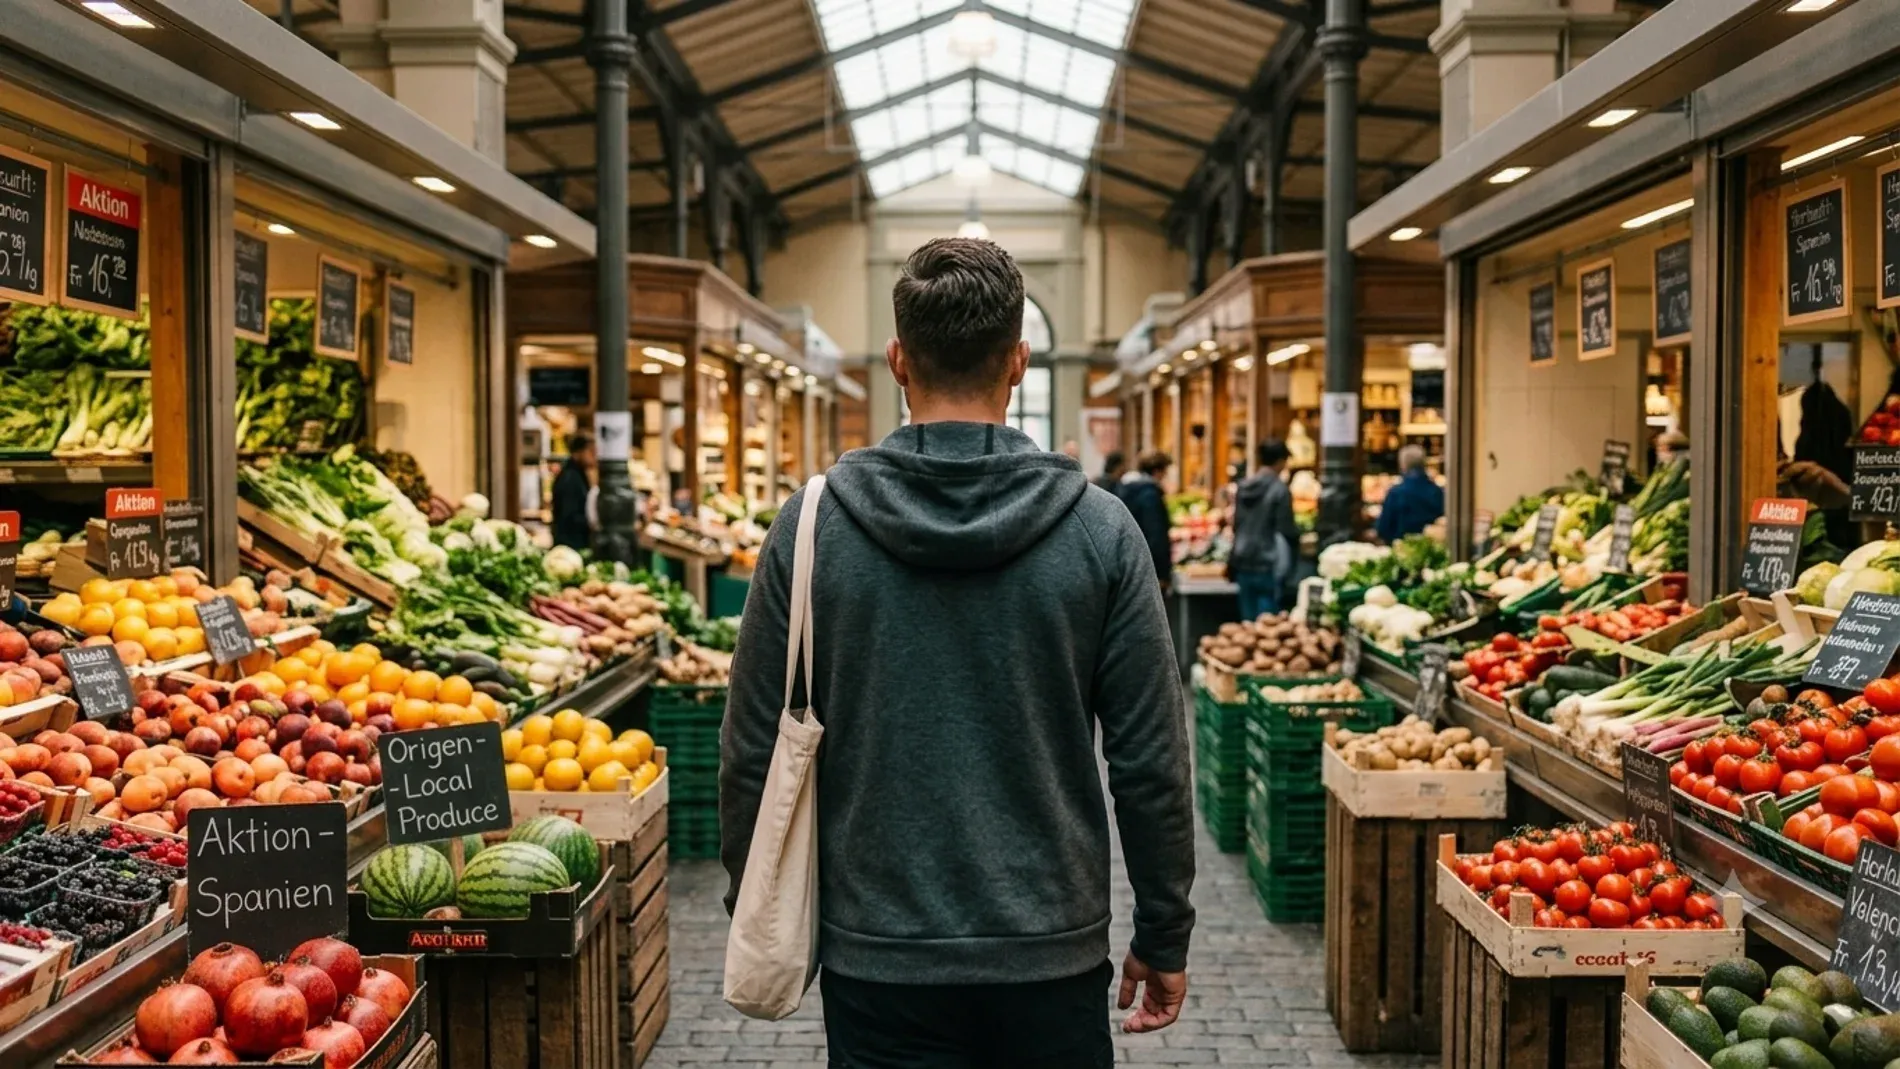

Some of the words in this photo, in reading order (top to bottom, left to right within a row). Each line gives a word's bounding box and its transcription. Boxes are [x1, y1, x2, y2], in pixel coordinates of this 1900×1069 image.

[80, 183, 129, 219] Aktion
[397, 801, 500, 835] Produce
[196, 877, 333, 929] Spanien
[1834, 938, 1849, 967] Fr
